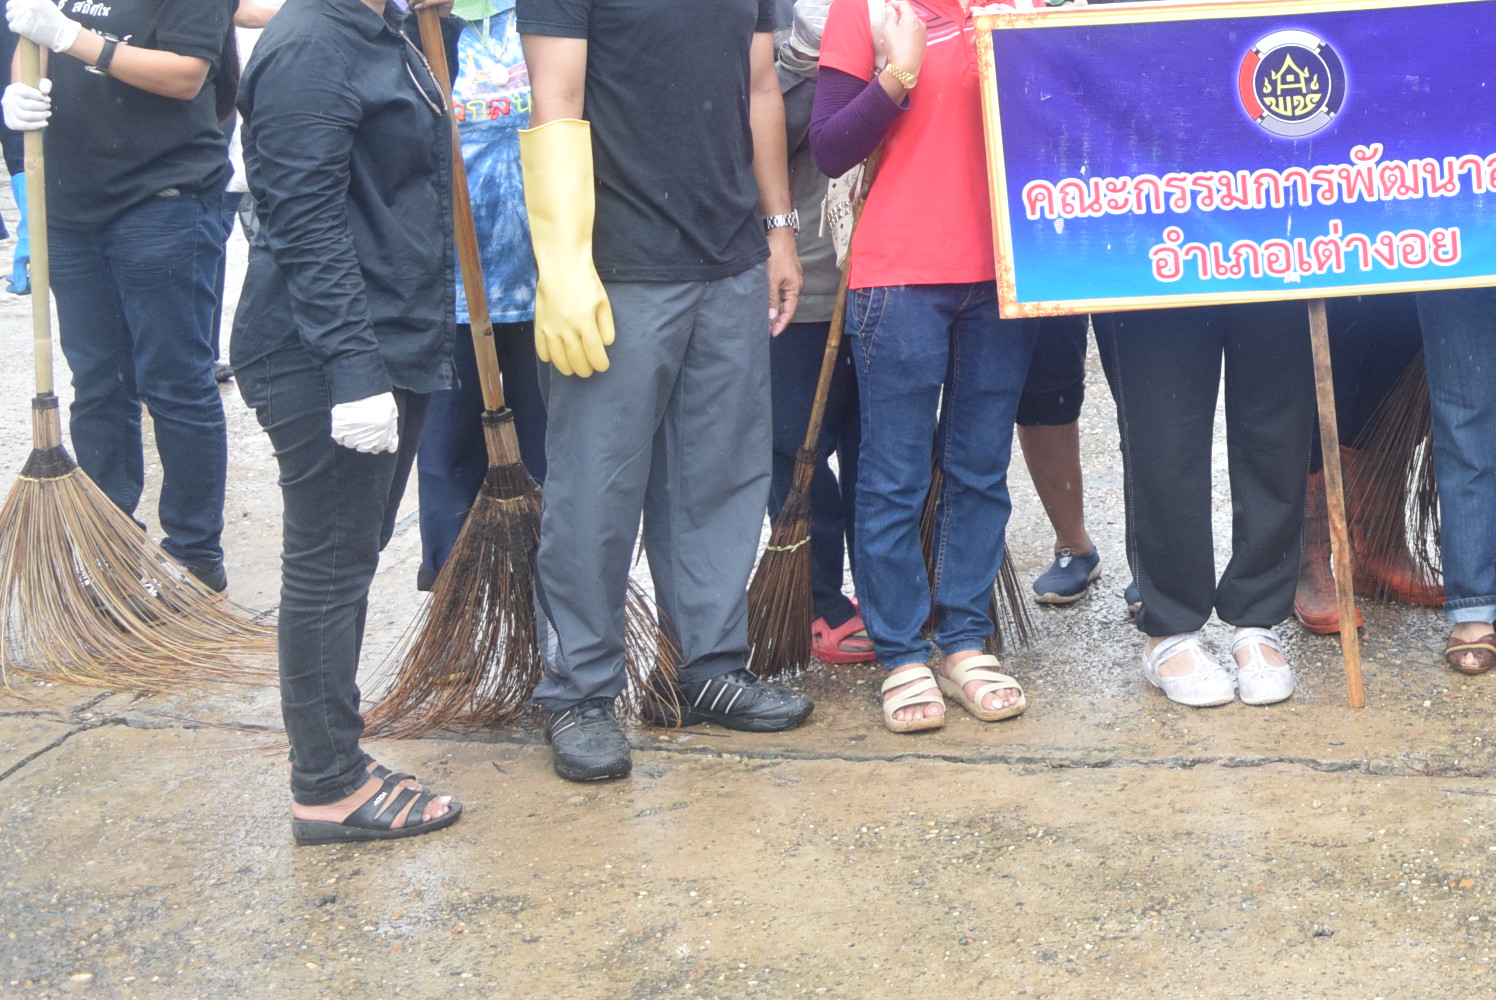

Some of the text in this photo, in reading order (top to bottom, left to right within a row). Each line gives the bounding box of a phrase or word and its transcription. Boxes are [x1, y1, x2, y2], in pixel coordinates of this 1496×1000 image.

[1151, 220, 1459, 282] อำเภอเต่างอย
